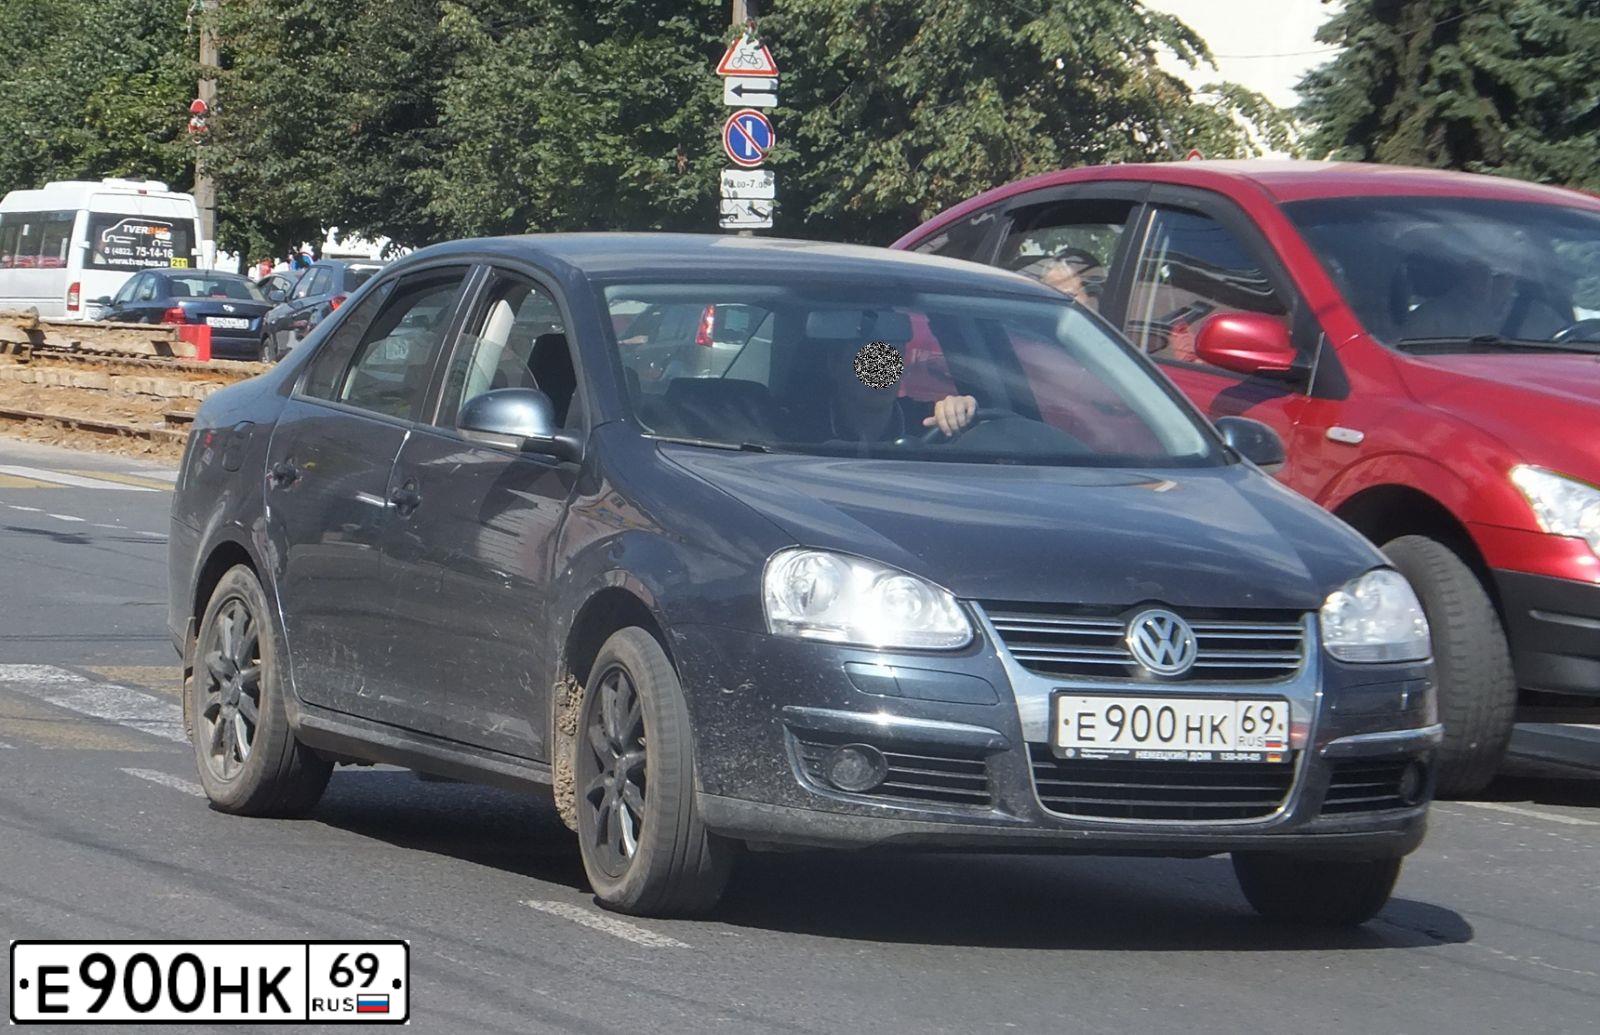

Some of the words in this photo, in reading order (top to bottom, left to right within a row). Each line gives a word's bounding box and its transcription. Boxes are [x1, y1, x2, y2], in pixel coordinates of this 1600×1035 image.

[136, 247, 174, 258] 75-14-16
[1241, 705, 1274, 734] 69
[1238, 736, 1263, 748] RUS
